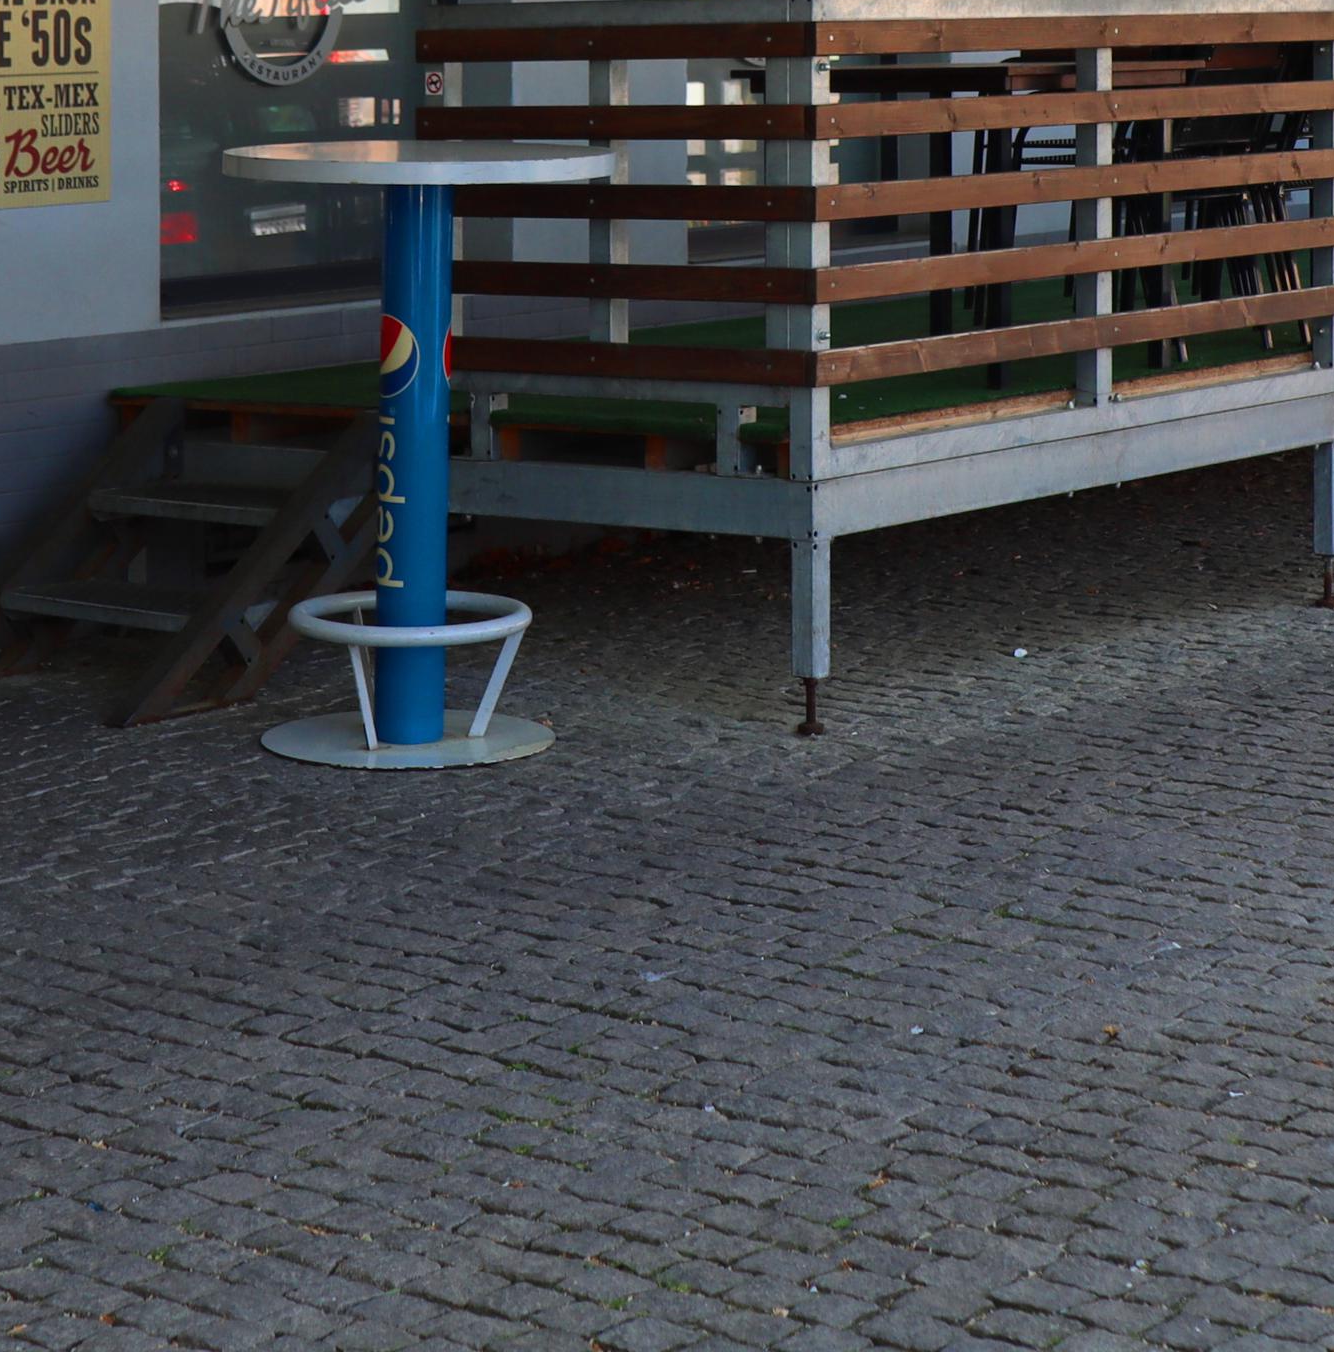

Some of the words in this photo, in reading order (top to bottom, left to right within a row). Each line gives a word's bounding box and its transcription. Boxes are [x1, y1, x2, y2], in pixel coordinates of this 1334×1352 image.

[3, 82, 99, 111] TEX-MEX
[41, 112, 100, 138] SLIDERS
[4, 128, 95, 178] Beer
[3, 178, 49, 194] SPIRITS
[57, 176, 99, 190] DRINKS
